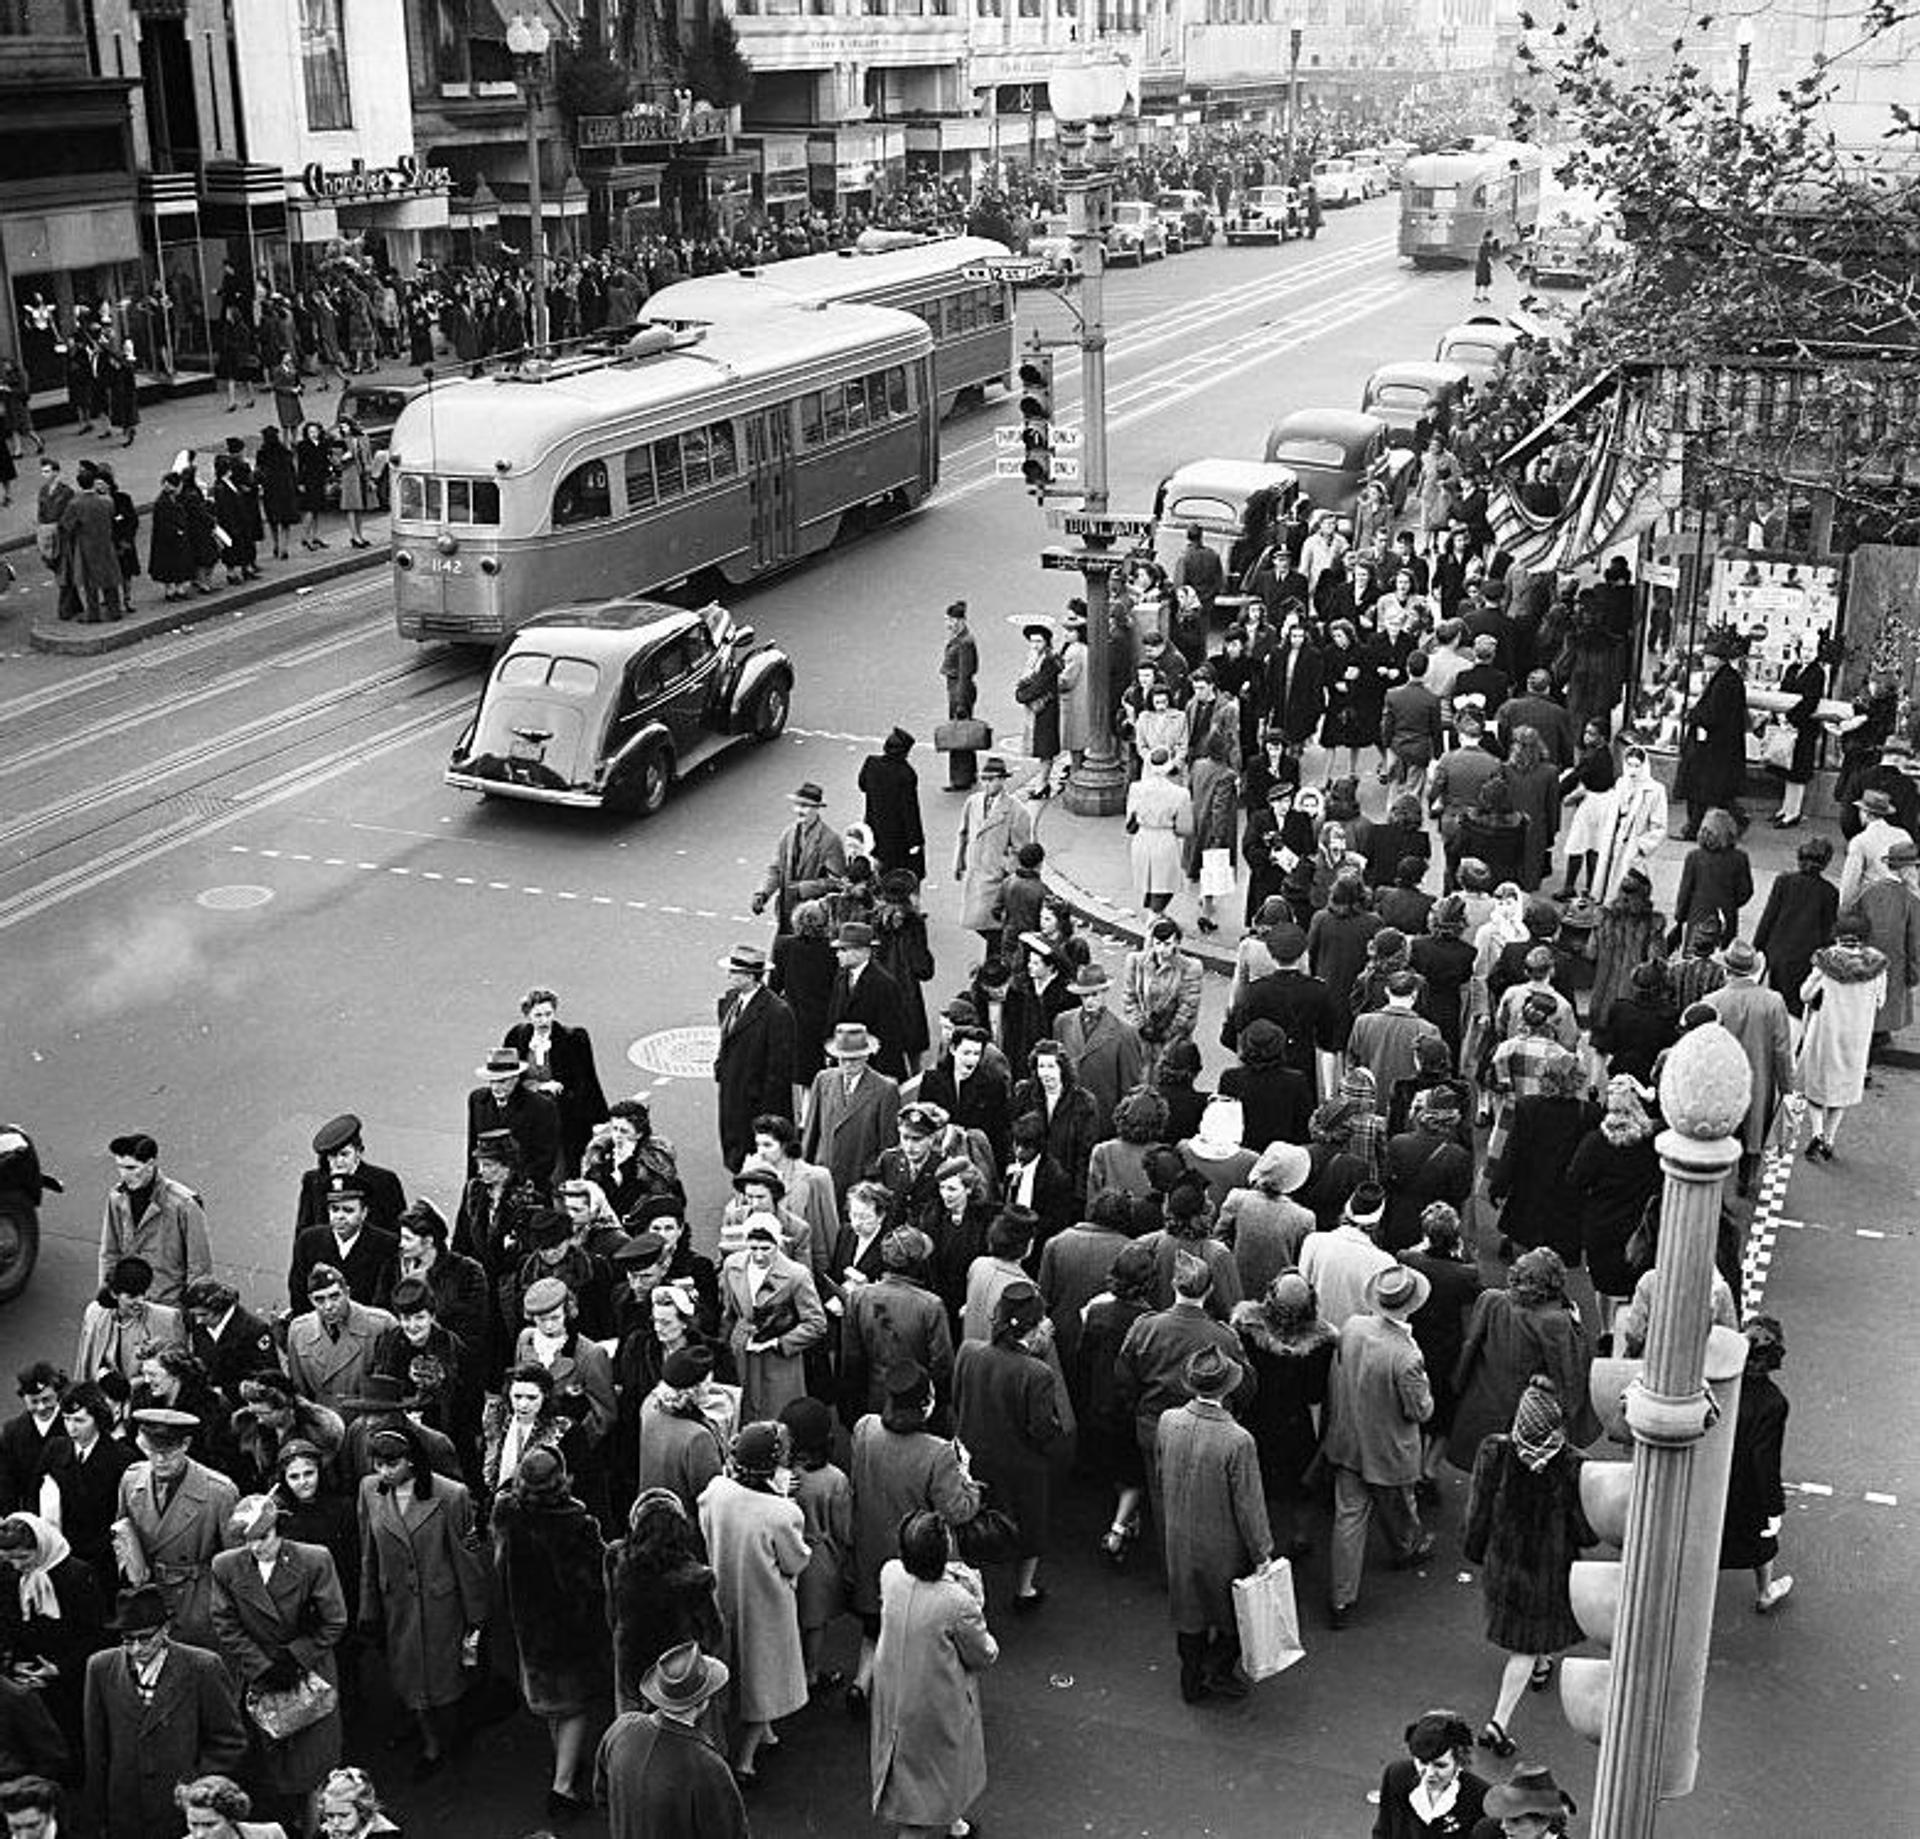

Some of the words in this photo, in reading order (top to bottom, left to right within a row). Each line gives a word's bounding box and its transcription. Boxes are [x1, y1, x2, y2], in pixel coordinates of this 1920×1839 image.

[400, 155, 455, 188] Shoes
[989, 267, 1003, 281] 12
[1053, 429, 1077, 444] ONLY
[1054, 460, 1077, 475] ONLY
[432, 558, 463, 574] 1142
